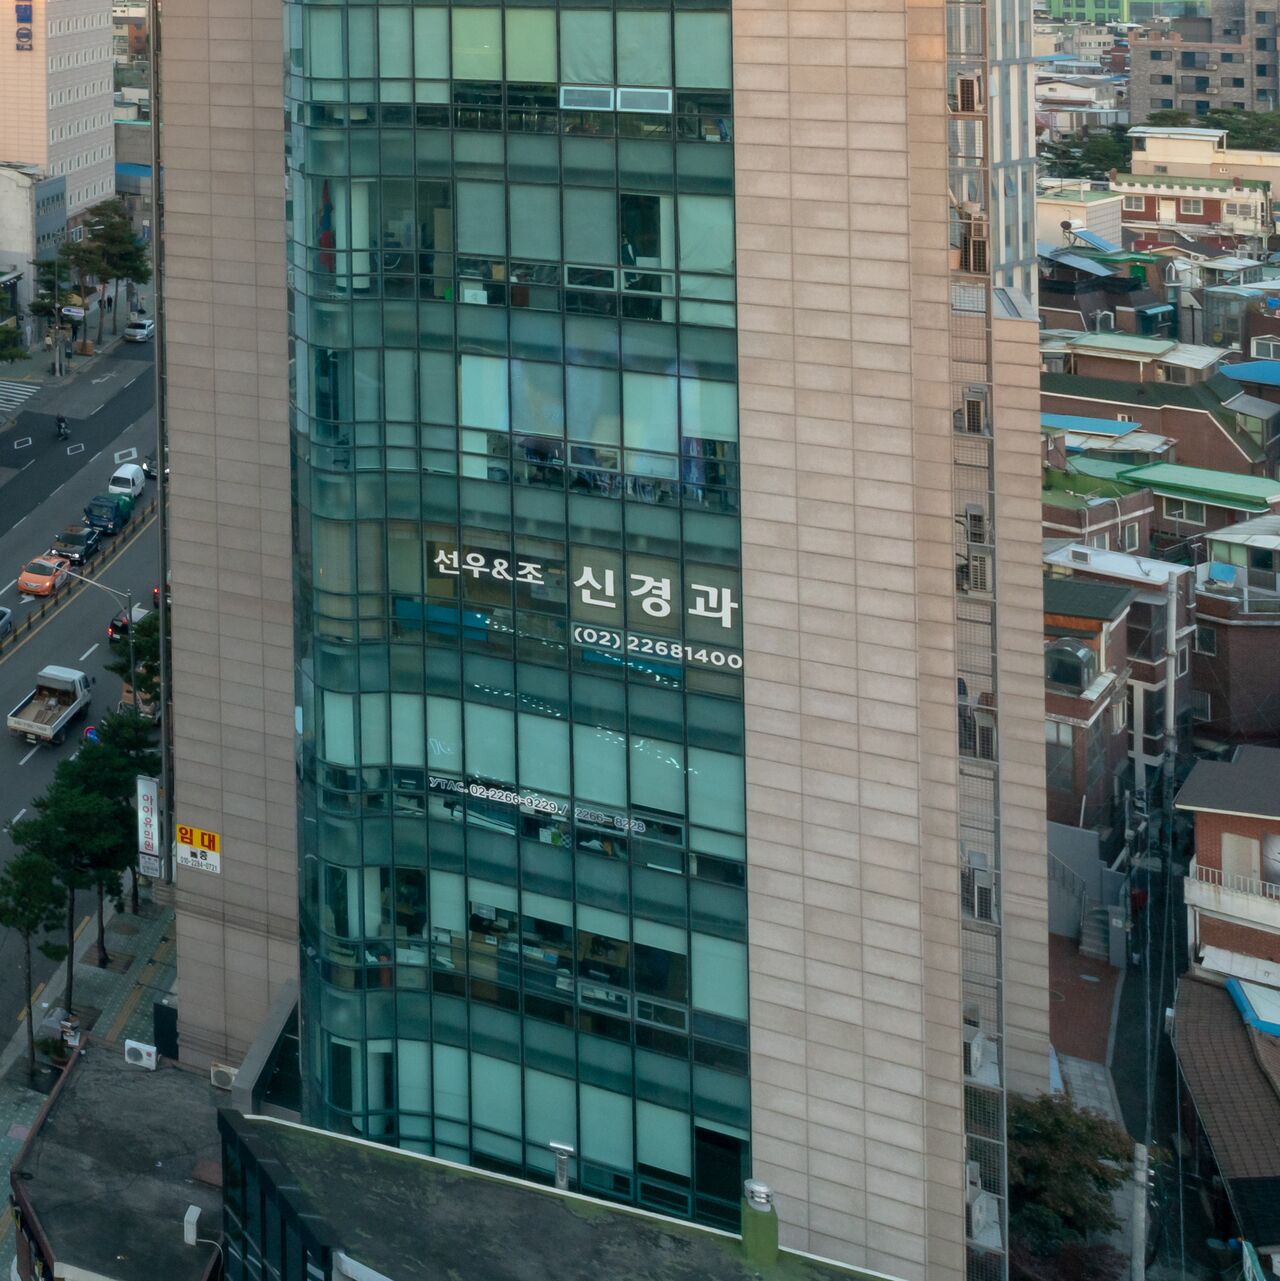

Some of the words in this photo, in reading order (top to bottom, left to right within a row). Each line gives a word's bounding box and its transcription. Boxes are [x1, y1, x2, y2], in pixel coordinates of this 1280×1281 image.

[433, 548, 545, 586] 선우&조
[573, 566, 739, 629] 신경과
[573, 627, 622, 650] (02)
[627, 635, 743, 670] 22681400
[178, 826, 216, 852] 임대
